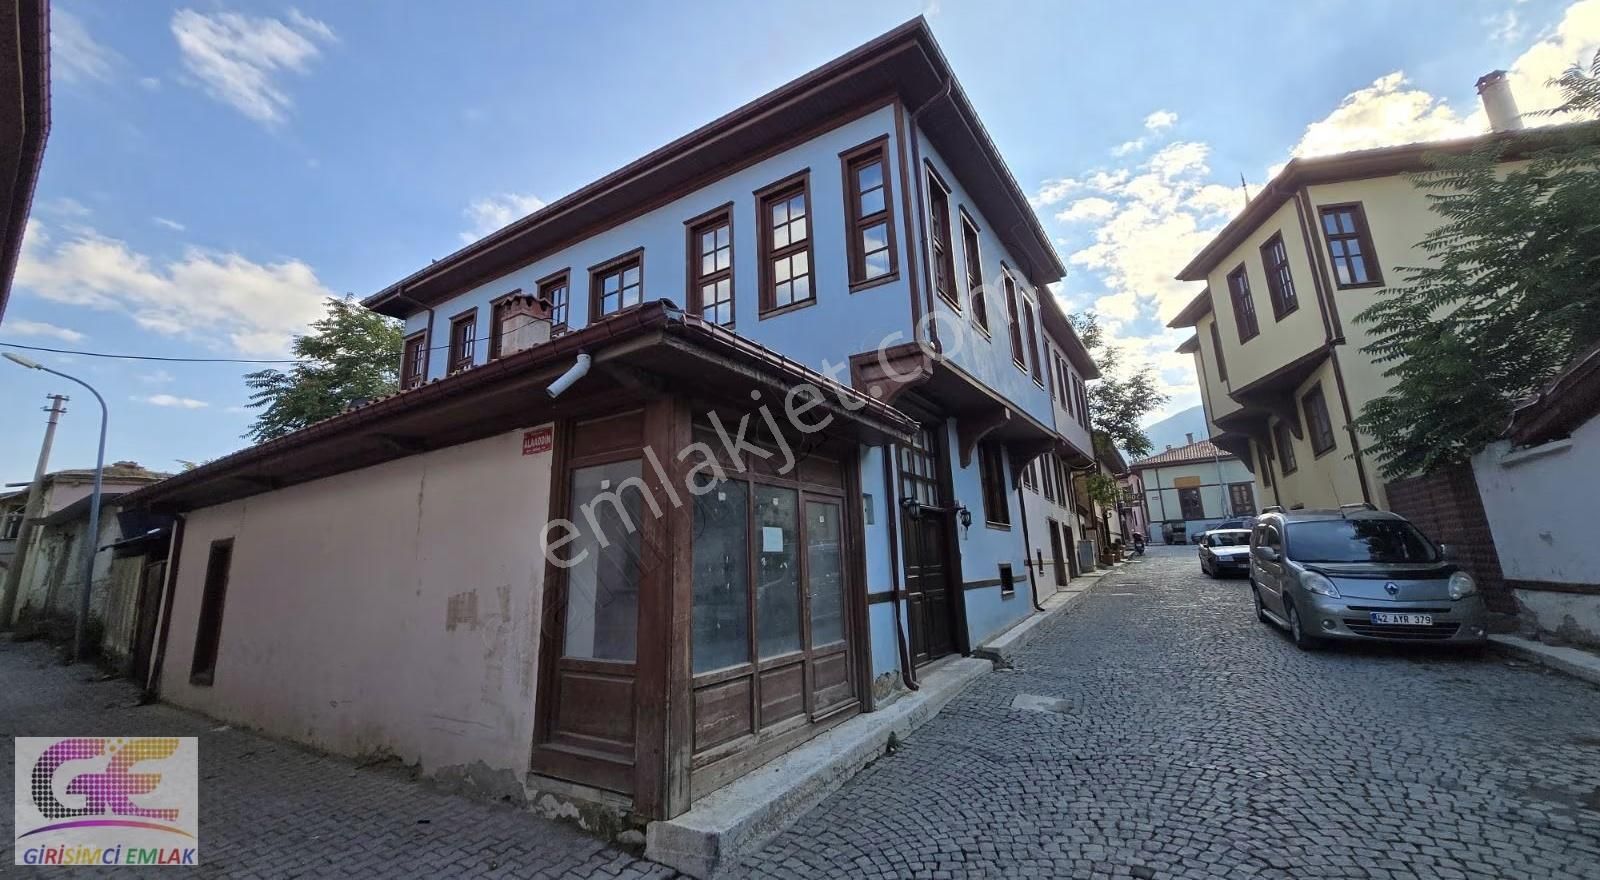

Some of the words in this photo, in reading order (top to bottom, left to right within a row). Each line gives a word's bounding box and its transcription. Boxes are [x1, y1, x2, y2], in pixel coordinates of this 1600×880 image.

[1377, 614, 1389, 623] 42
[1393, 615, 1409, 623] AYR
[1414, 616, 1431, 624] 379
